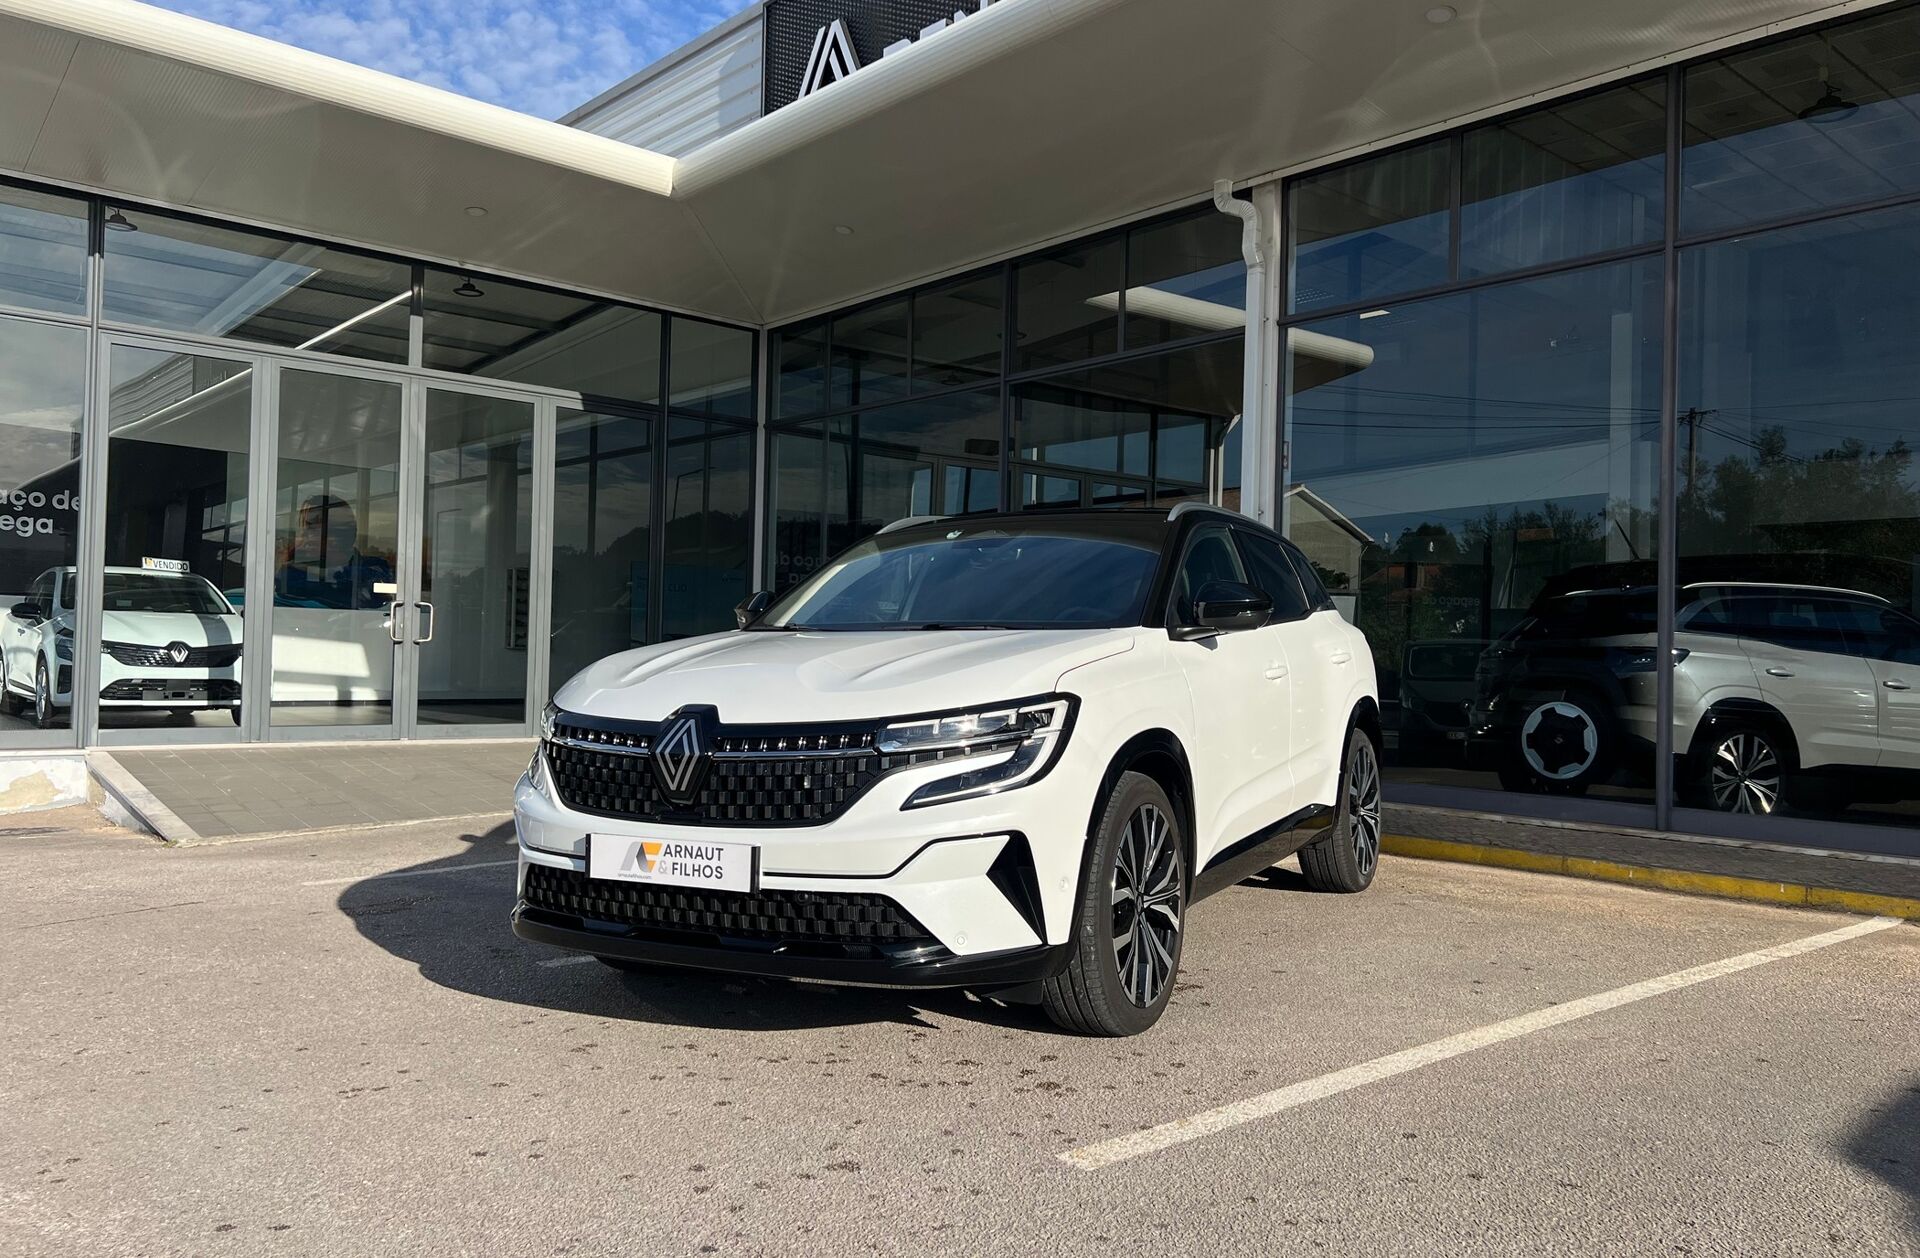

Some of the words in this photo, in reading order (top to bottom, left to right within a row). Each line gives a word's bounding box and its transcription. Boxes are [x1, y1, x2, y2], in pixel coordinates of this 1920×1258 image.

[0, 514, 53, 538] ega
[153, 559, 188, 571] VENDIDO
[663, 843, 724, 862] ARNAUT
[658, 861, 668, 874] &
[671, 862, 723, 879] FILHOS
